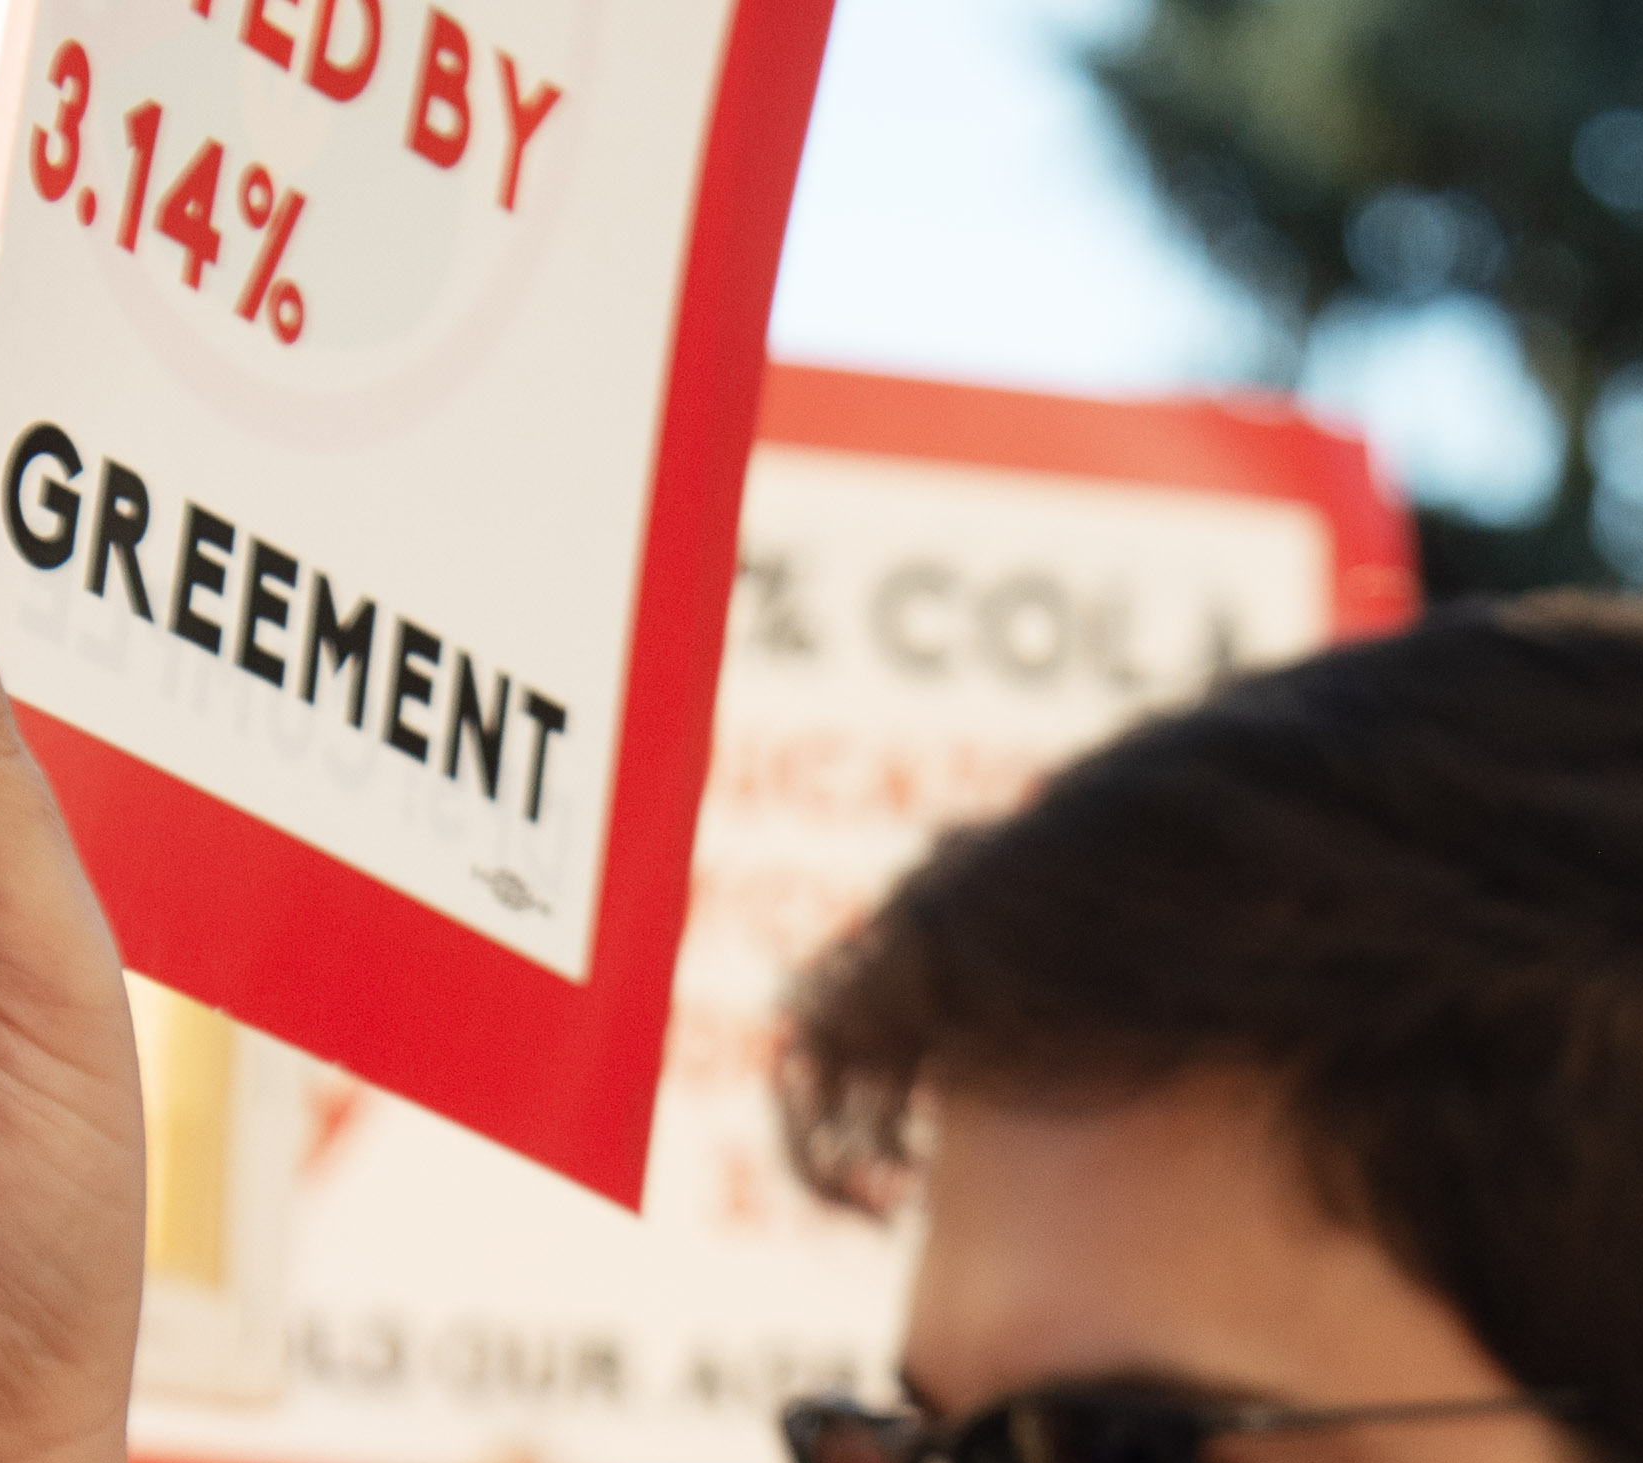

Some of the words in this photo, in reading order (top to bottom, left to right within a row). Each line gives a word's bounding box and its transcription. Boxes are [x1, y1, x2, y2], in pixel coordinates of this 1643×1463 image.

[29, 37, 307, 345] 3.14%
[189, 0, 383, 103] ED
[404, 3, 563, 213] BY
